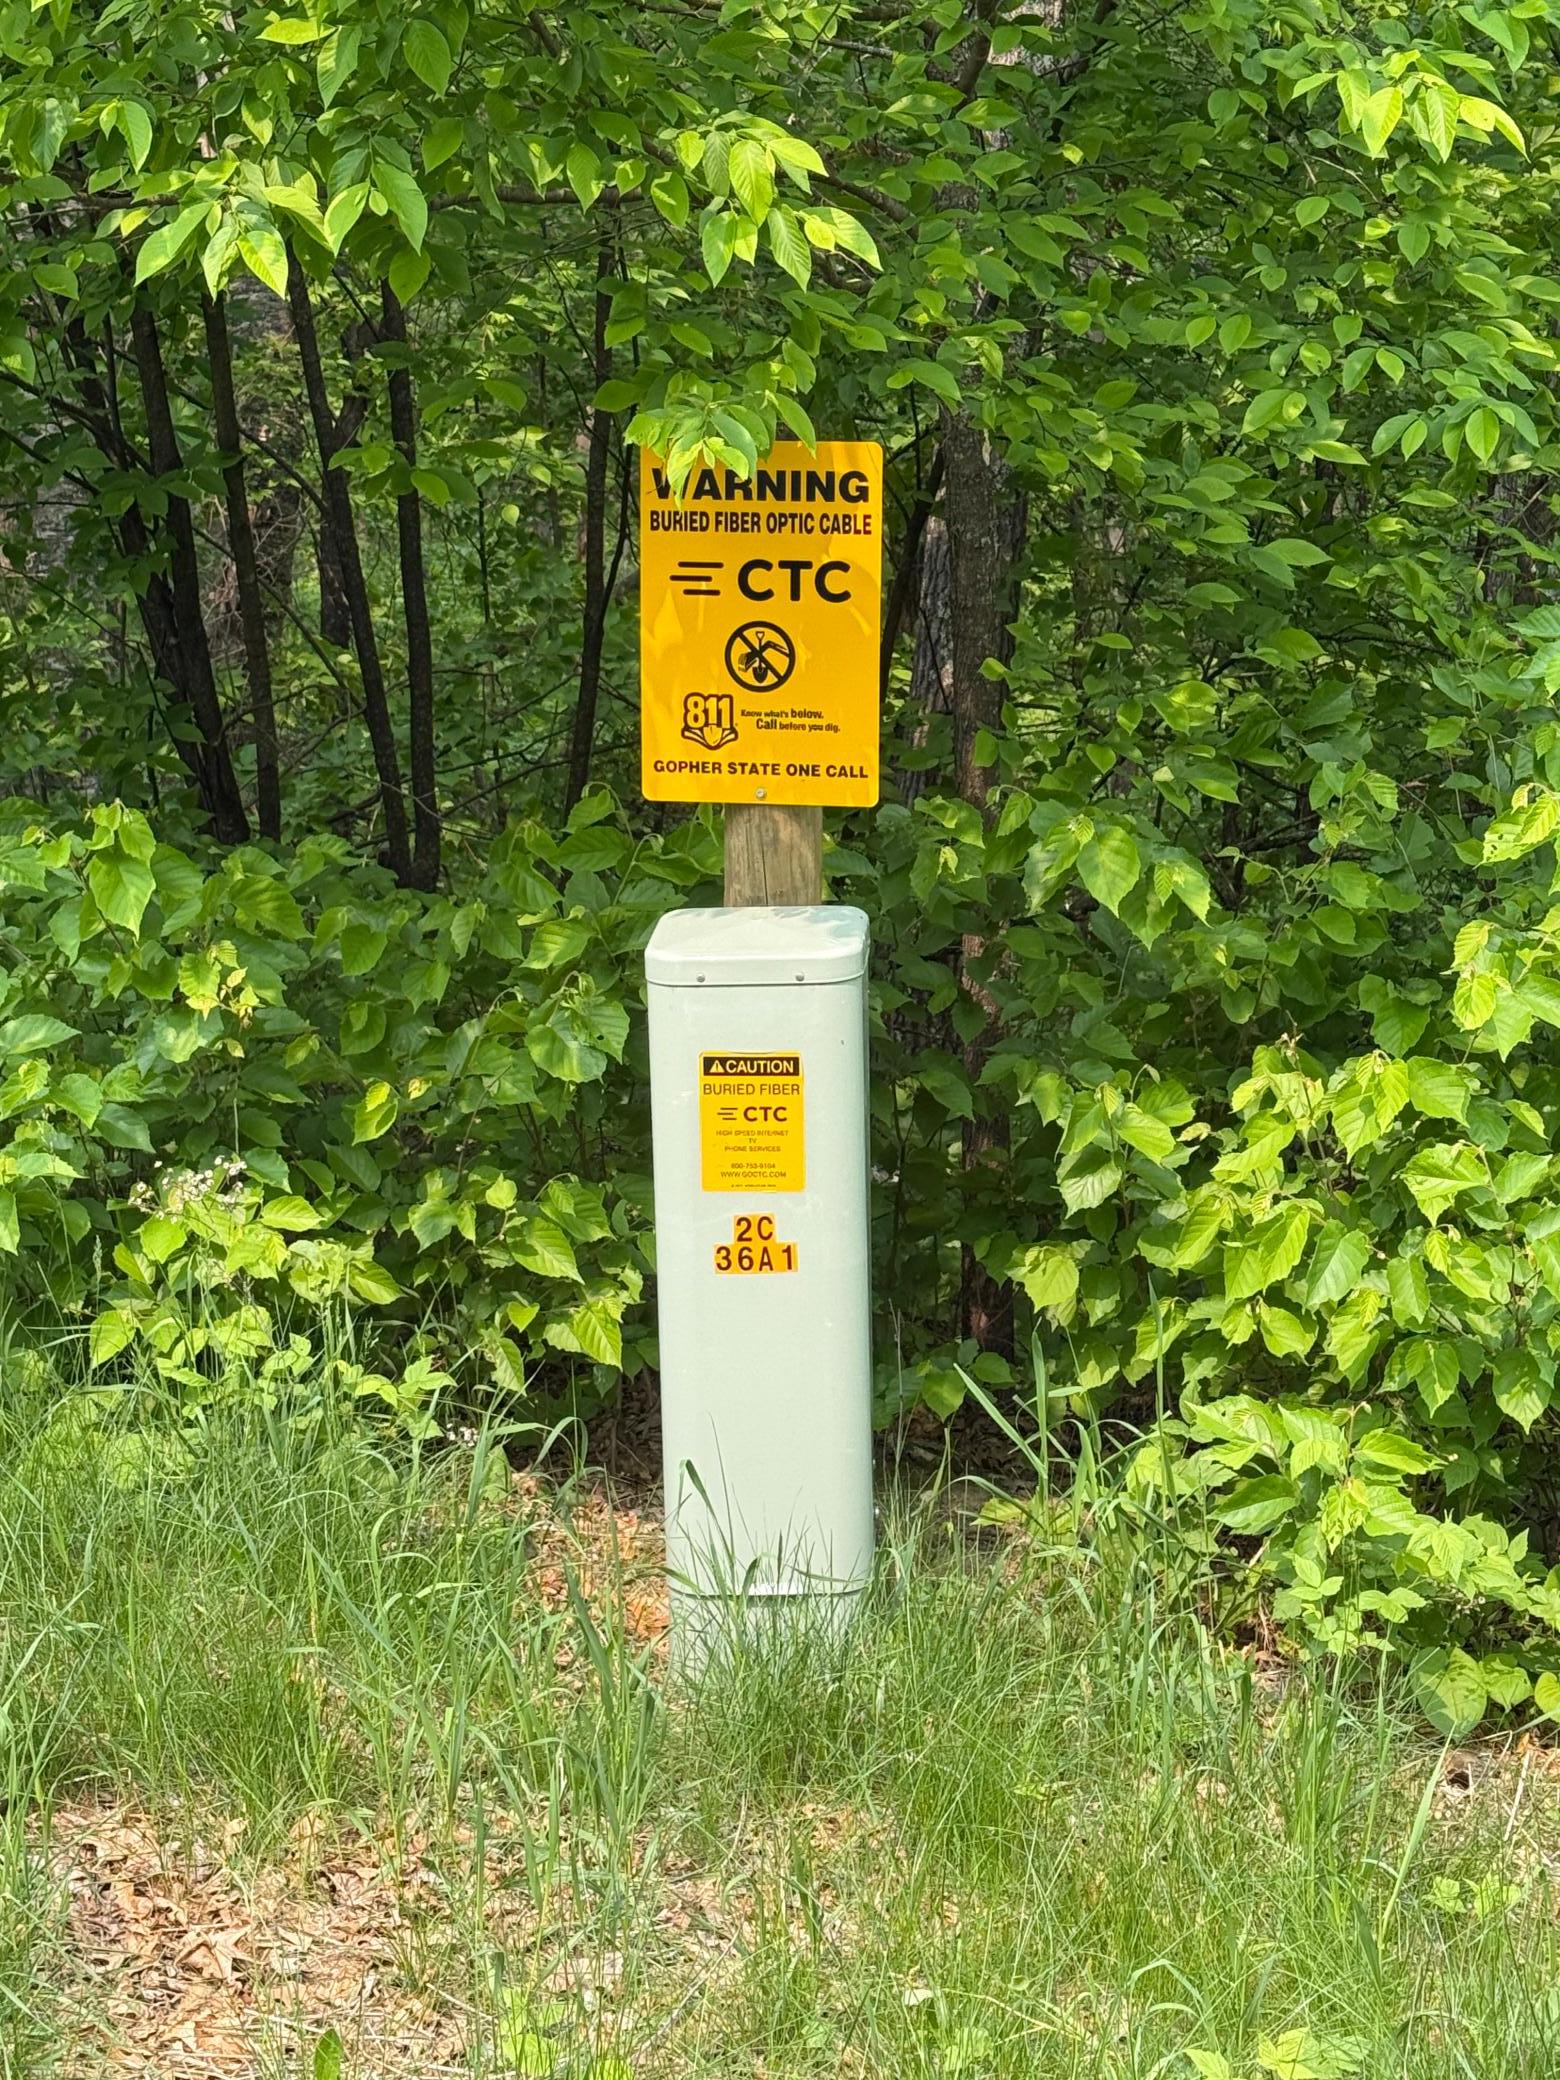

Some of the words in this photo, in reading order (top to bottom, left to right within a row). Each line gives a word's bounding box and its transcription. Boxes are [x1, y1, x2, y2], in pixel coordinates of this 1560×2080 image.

[652, 468, 869, 503] WARNING
[650, 510, 710, 532] BURIED
[714, 511, 761, 533] FIBER
[766, 512, 815, 535] OPTIC
[819, 513, 872, 535] CABLE
[737, 558, 851, 603] CTC
[684, 692, 734, 730] 811
[741, 708, 762, 718] Know
[763, 708, 789, 718] what's
[790, 707, 824, 719] below.
[756, 718, 777, 730] Call
[779, 721, 807, 731] before
[808, 723, 824, 732] you
[825, 722, 841, 734] dig.
[653, 760, 722, 775] GOPHER
[727, 762, 781, 776] STATE
[786, 764, 821, 777] ONE
[826, 765, 868, 779] CALL
[725, 1060, 794, 1073] CAUTION
[703, 1083, 755, 1095] BURIED
[759, 1083, 800, 1095] FIBER
[743, 1106, 788, 1122] CTC
[736, 1216, 773, 1242] 2C
